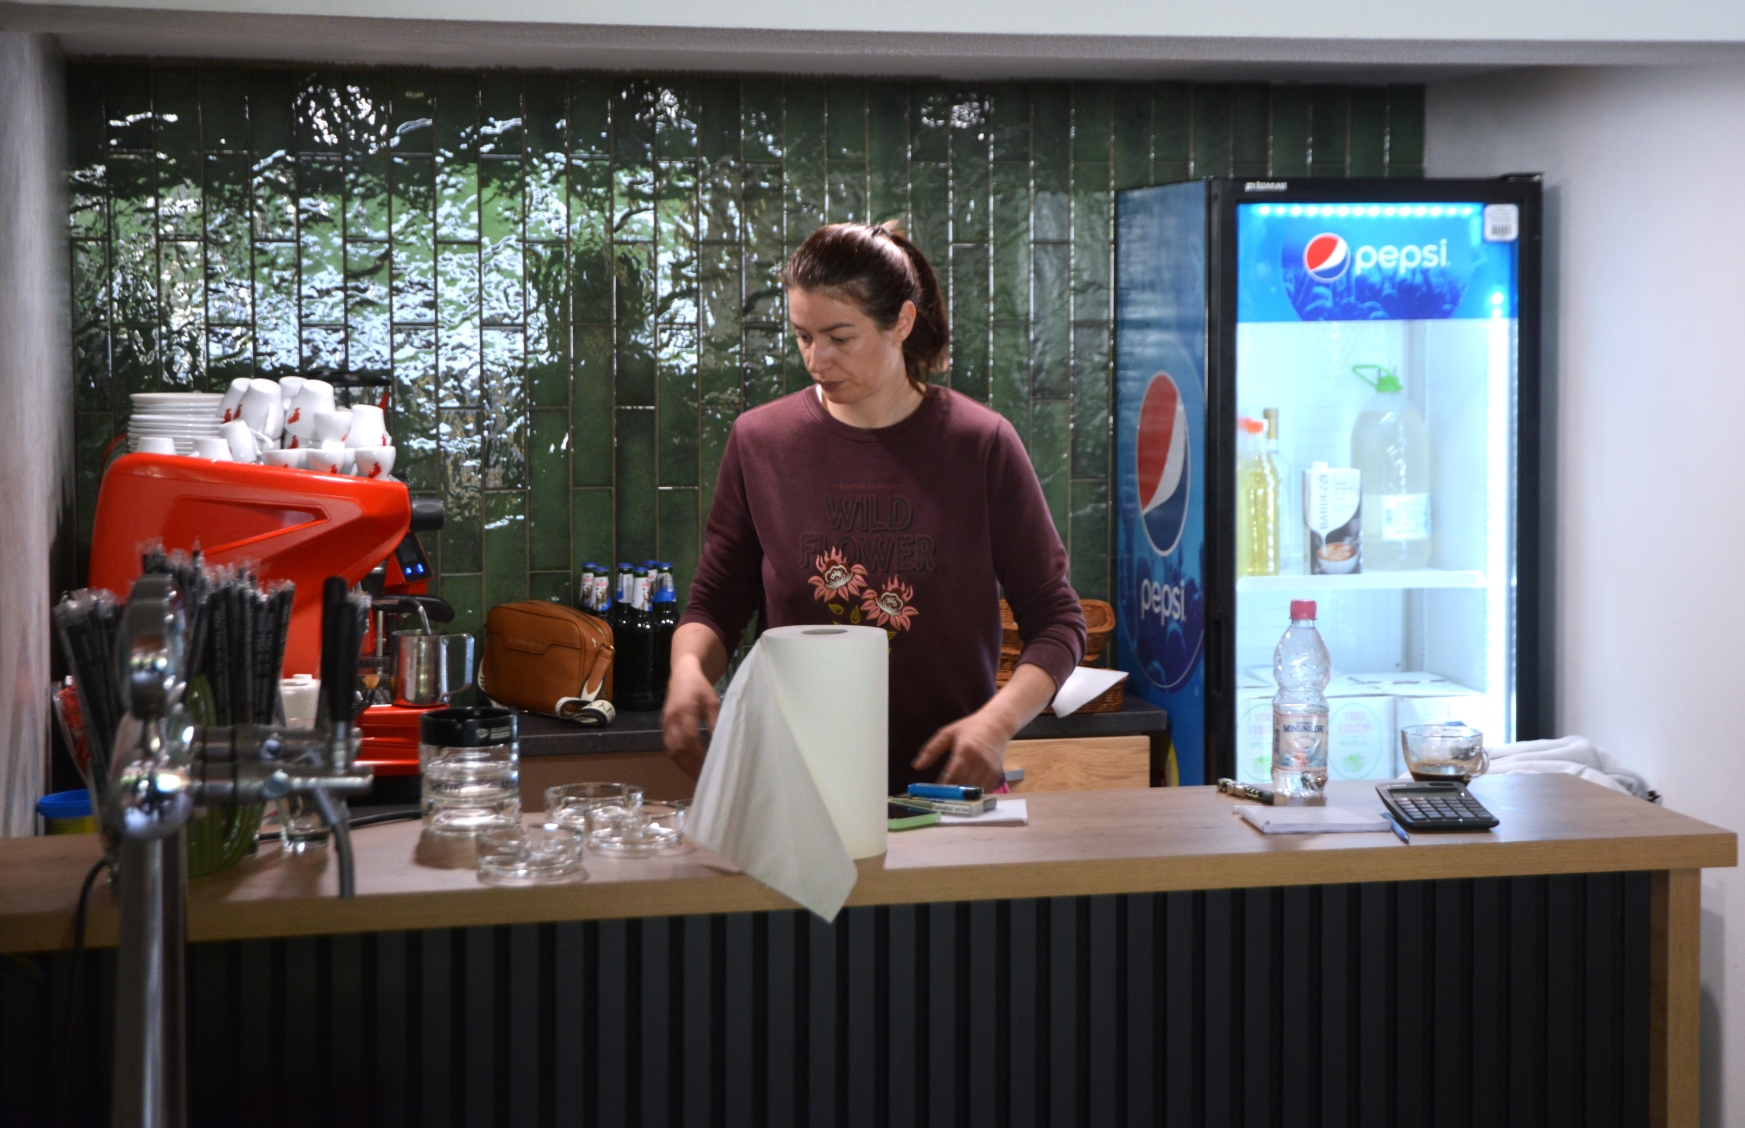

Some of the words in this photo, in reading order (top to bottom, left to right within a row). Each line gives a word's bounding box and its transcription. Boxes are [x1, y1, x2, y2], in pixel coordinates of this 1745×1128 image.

[1355, 238, 1448, 275] pepsi
[824, 495, 912, 531] WILD
[1141, 578, 1185, 626] pepsi
[1283, 724, 1324, 733] MINUNILOR
